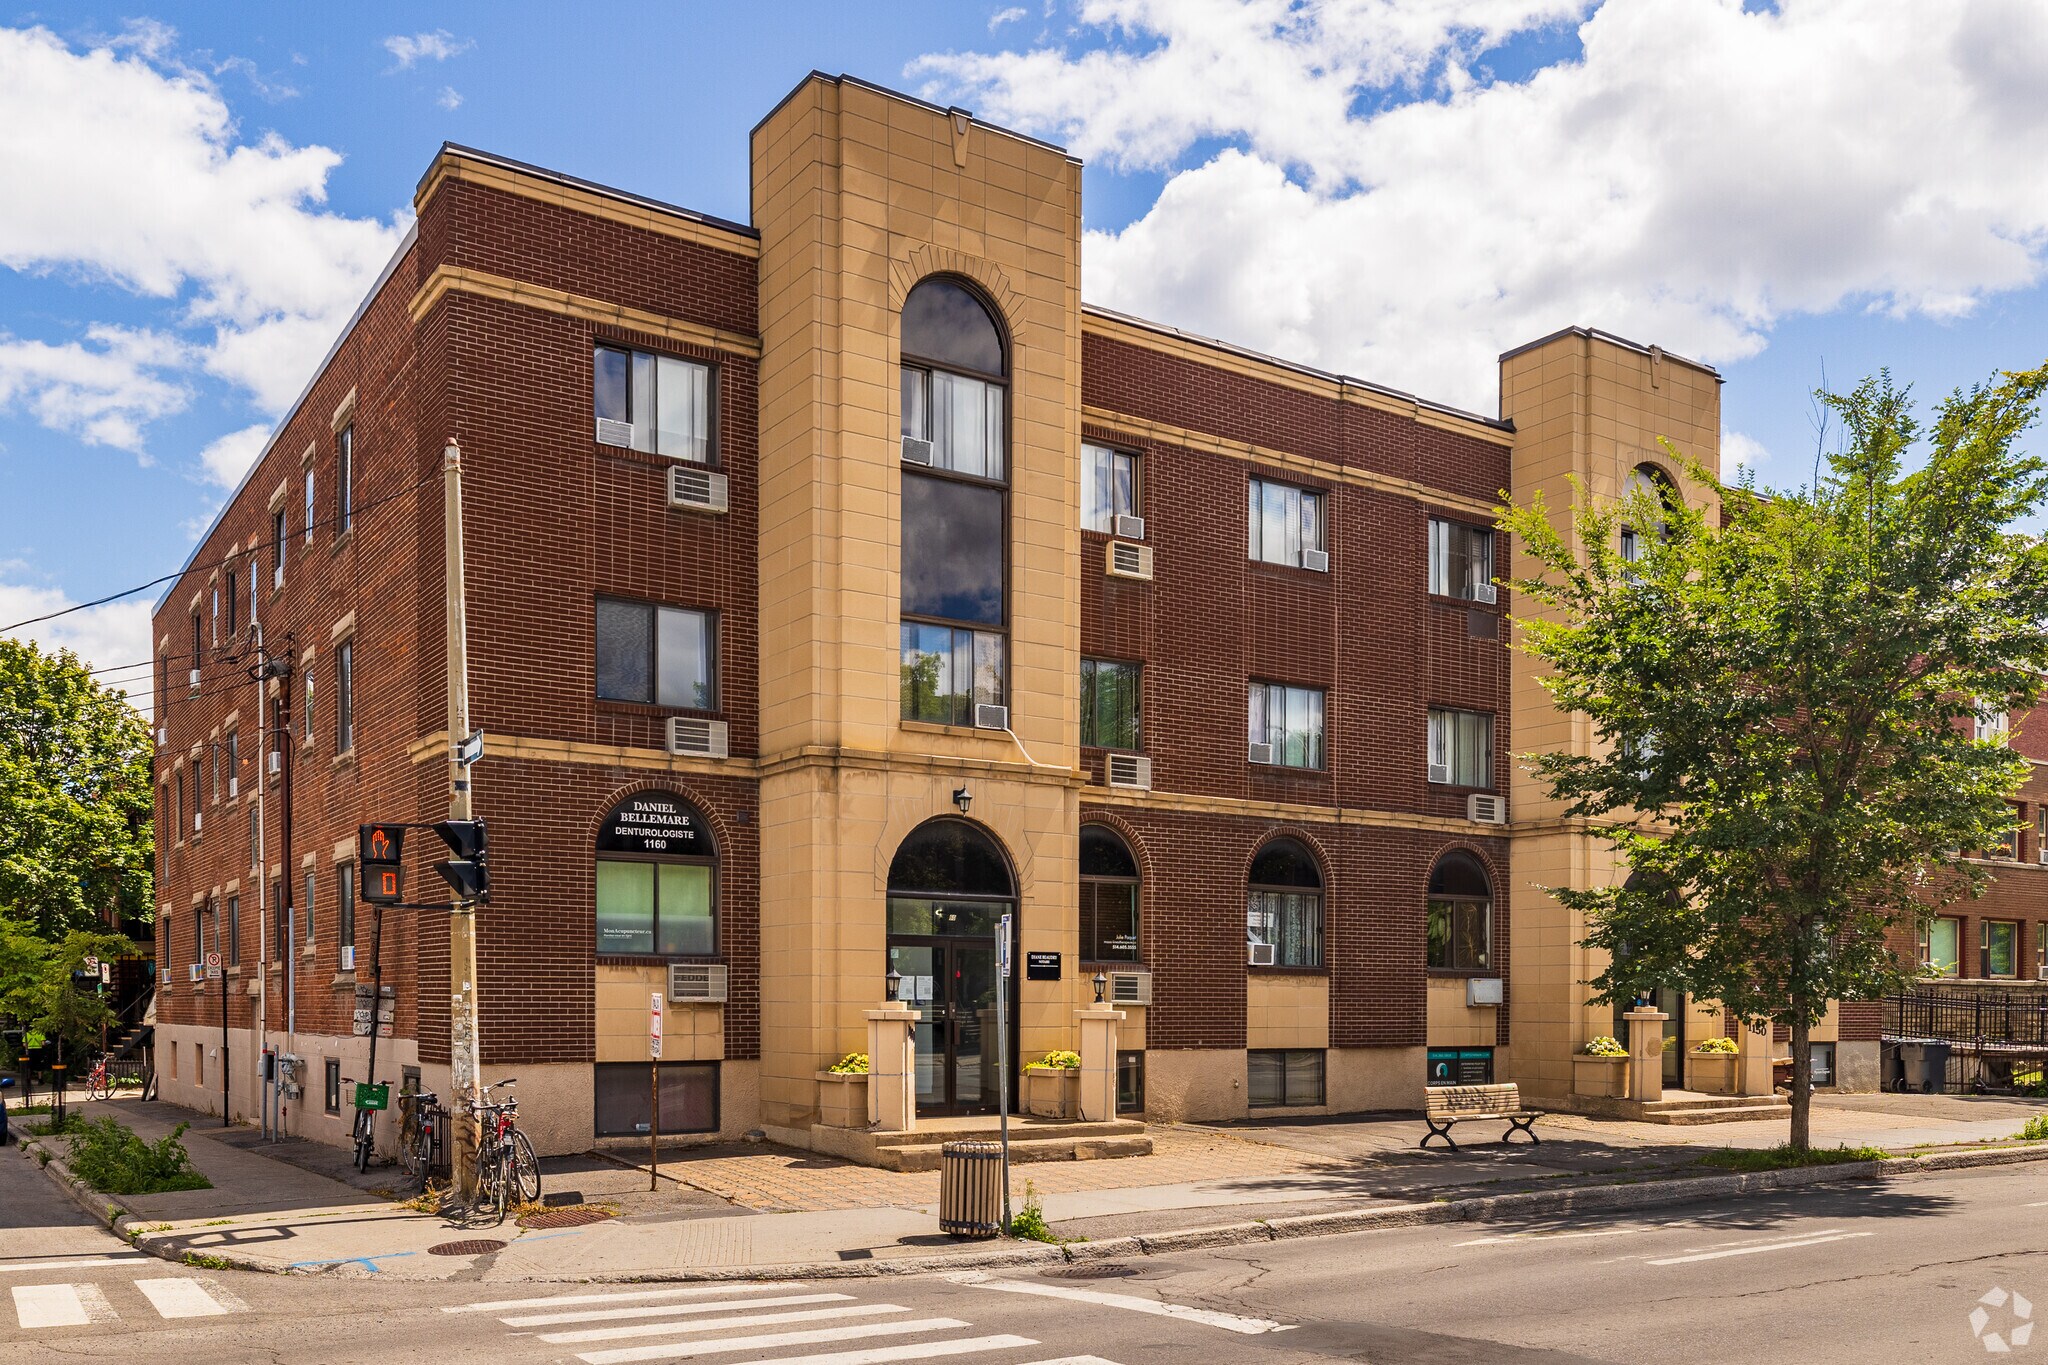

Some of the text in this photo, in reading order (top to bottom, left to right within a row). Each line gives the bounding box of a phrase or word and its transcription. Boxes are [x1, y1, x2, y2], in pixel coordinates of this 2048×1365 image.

[633, 801, 677, 813] DANIEL
[620, 812, 690, 826] BELLEMARE
[615, 826, 694, 839] DENTUROLOGISTE
[644, 839, 667, 849] 1160
